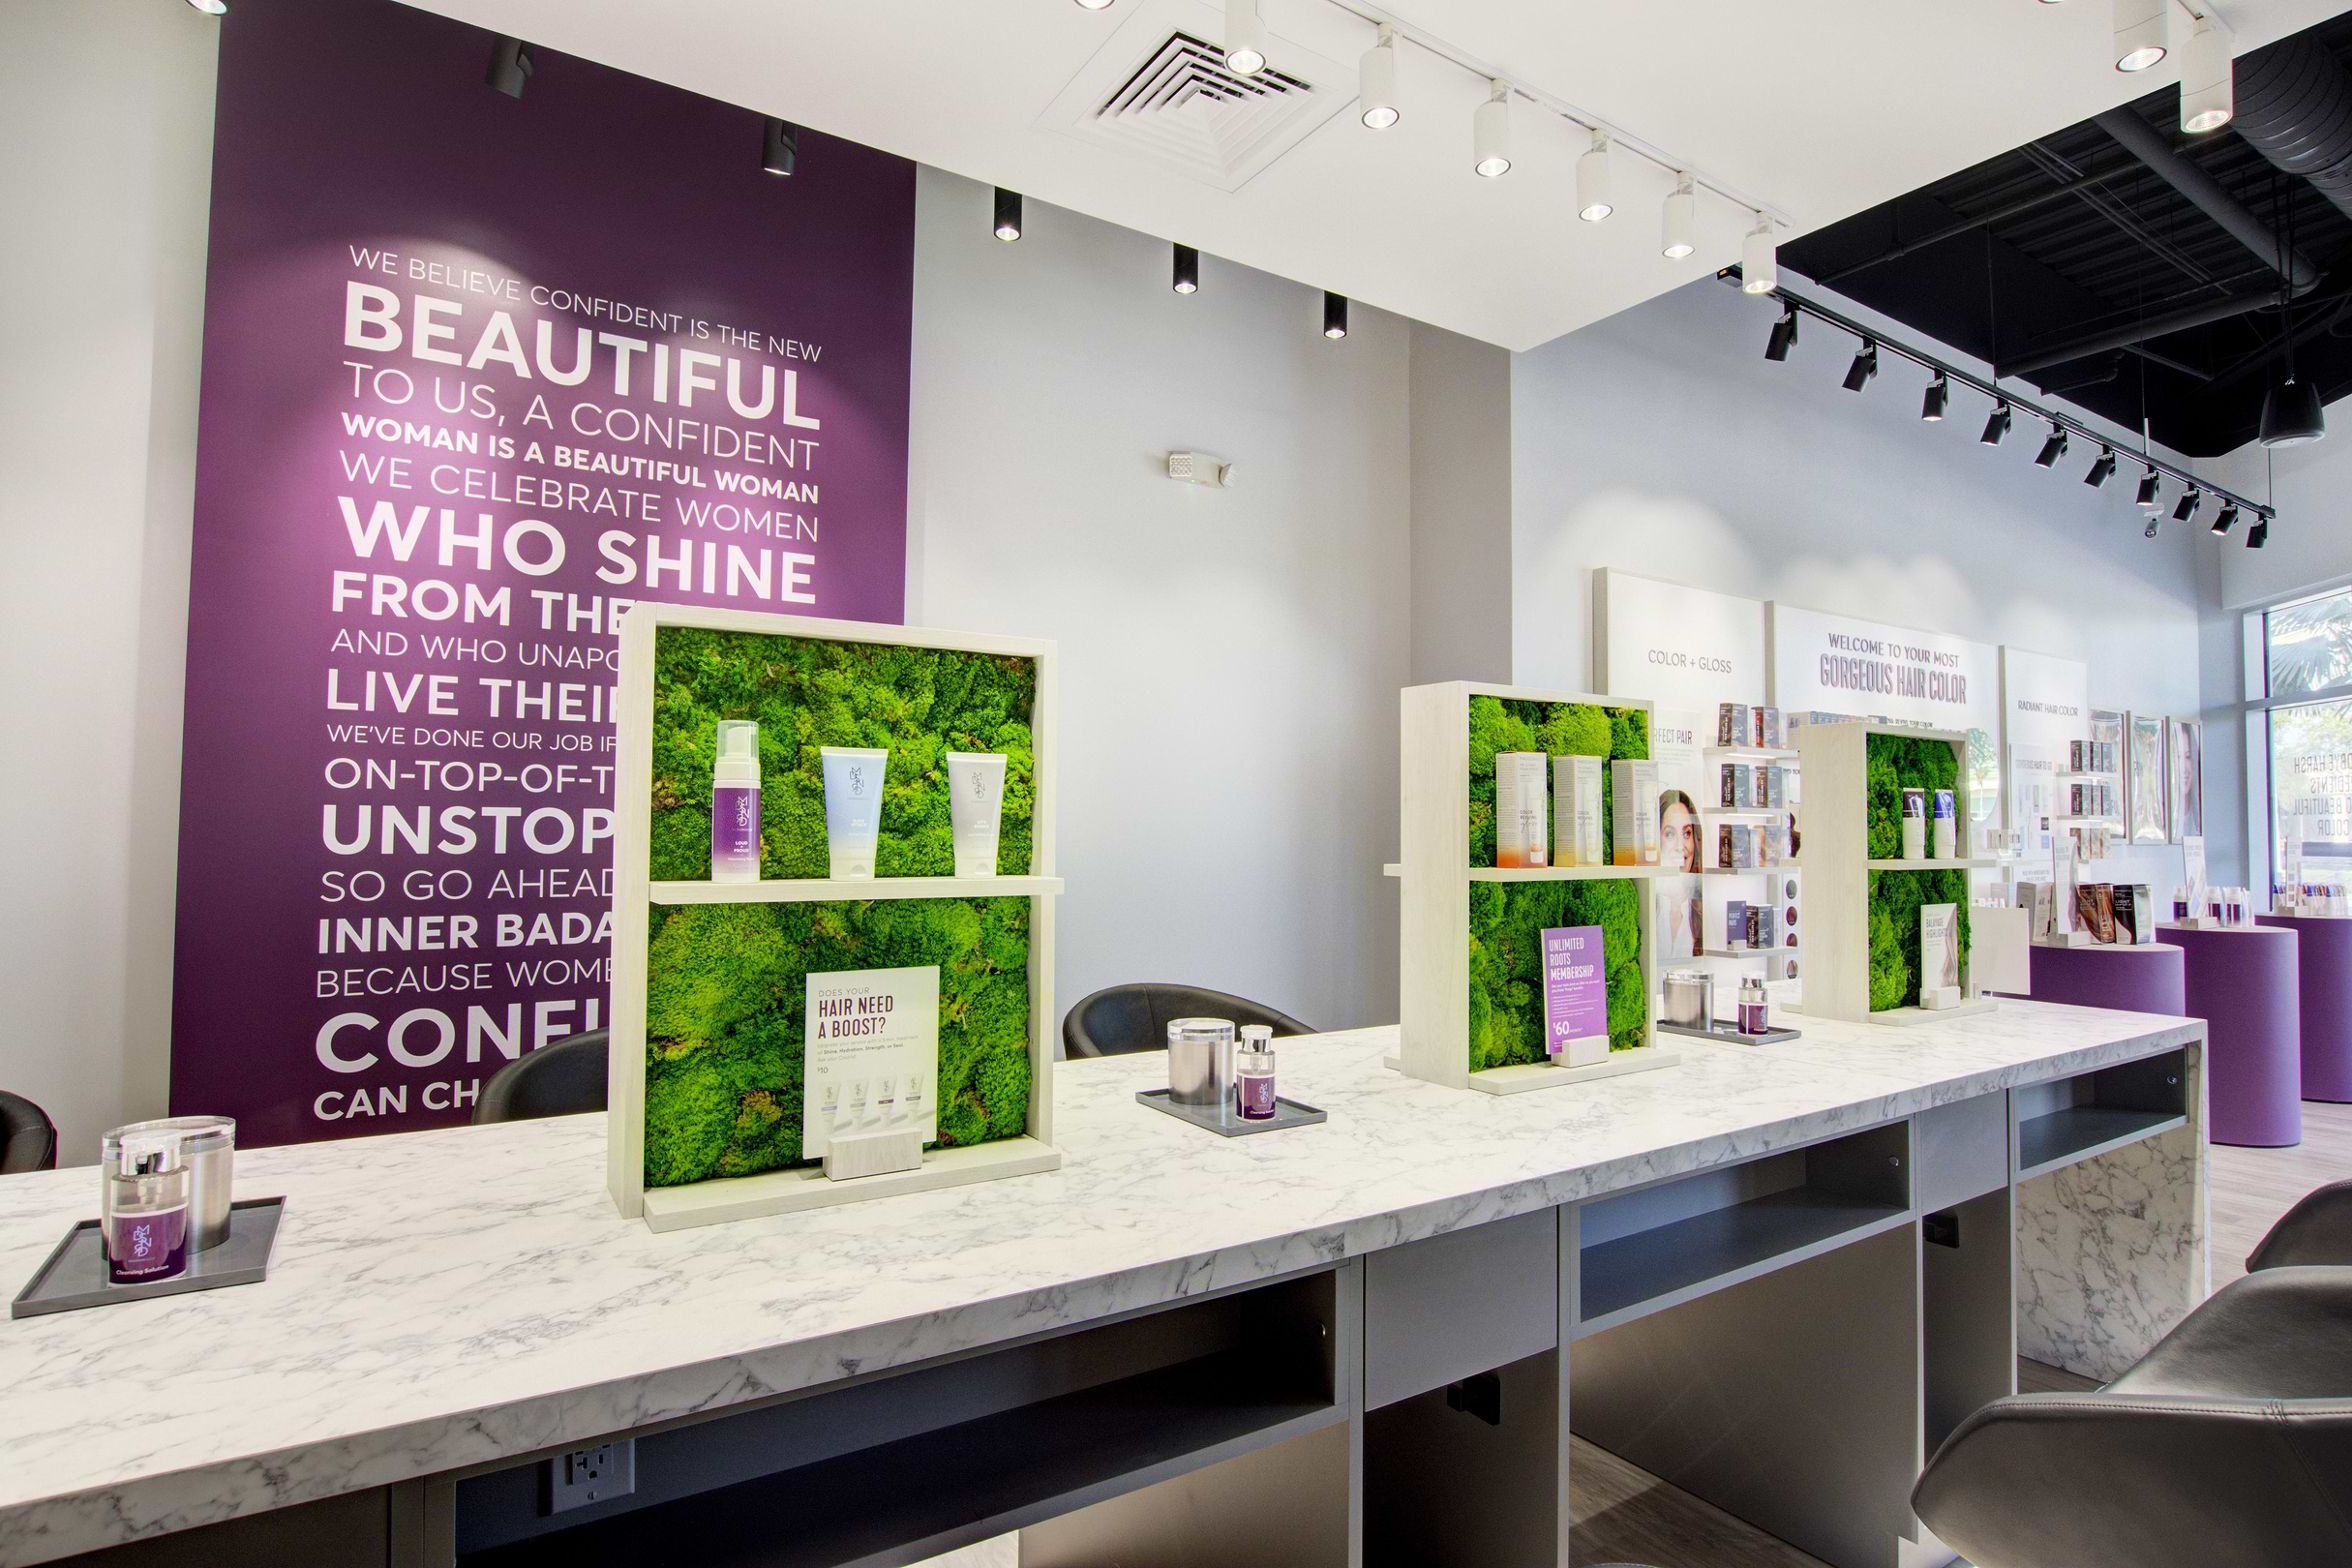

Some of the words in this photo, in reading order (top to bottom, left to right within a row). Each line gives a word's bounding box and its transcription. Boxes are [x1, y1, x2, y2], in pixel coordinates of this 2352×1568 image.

[349, 245, 398, 275] WE
[409, 258, 521, 300] BELIEVE
[530, 286, 681, 334] CONFIDENT
[691, 319, 709, 339] IS
[717, 324, 761, 350] THE
[769, 337, 822, 363] NEW
[344, 281, 821, 430] BEAUTIFUL
[343, 361, 414, 404] TO
[435, 377, 503, 427] US,
[523, 395, 554, 430] A
[571, 403, 820, 470] CONFIDENT
[341, 412, 477, 455] WOMAN
[489, 434, 515, 460] IS
[524, 442, 545, 464] A
[555, 446, 707, 488] BEAUTIFUL
[714, 470, 819, 504] WOMAN
[339, 450, 412, 490] WE
[430, 466, 661, 522] CELEBRATE
[676, 498, 818, 543] WOMEN
[338, 496, 565, 576] WHO
[595, 530, 816, 605] SHINE
[332, 570, 511, 626] FROM
[531, 590, 635, 636] THE
[330, 629, 407, 657] AND
[420, 635, 506, 663] WHO
[1648, 649, 1687, 668] COLOR
[1689, 658, 1696, 668] +
[1699, 657, 1732, 674] GLOSS
[1828, 633, 1884, 656] WELCOME
[1887, 643, 1901, 658] TO
[1904, 646, 1930, 663] YOUR
[1933, 651, 1960, 668] MOST
[327, 668, 459, 715] LIVE
[1820, 653, 1893, 695] GORGEOUS
[1897, 665, 1926, 699] HAIR
[1929, 670, 1966, 704] COLOR
[2018, 700, 2043, 713] RADIANT
[2044, 703, 2058, 715] HAIR
[2059, 705, 2078, 717] COLOR
[326, 724, 406, 745] WE'VE
[414, 727, 485, 748] DONE
[493, 731, 542, 751] OUR
[549, 733, 593, 752] JOB
[601, 736, 617, 753] IF
[1677, 729, 1692, 745] PAIR
[324, 757, 615, 794] ON-TOP-OF-T
[321, 804, 616, 855] UNSTOP
[319, 869, 385, 902] SO
[402, 868, 472, 901] GO
[318, 915, 478, 954] INNER
[497, 912, 612, 947] BADA
[1549, 937, 1584, 952] UNLIMITED
[1550, 953, 1571, 966] ROOTS
[1551, 965, 1594, 981] MEMBERSHIP
[317, 962, 493, 998] BECAUSE
[818, 989, 843, 997] DOES
[846, 987, 869, 995] YOUR
[819, 998, 853, 1018] HAIR
[858, 995, 893, 1015] NEED
[315, 998, 599, 1073] CONFI
[818, 1021, 826, 1039] A
[832, 1017, 886, 1038] BOOST?
[1553, 1021, 1569, 1036] $60
[313, 1084, 407, 1121] CAN
[422, 1078, 479, 1110] CH
[144, 1265, 169, 1273] Solution
